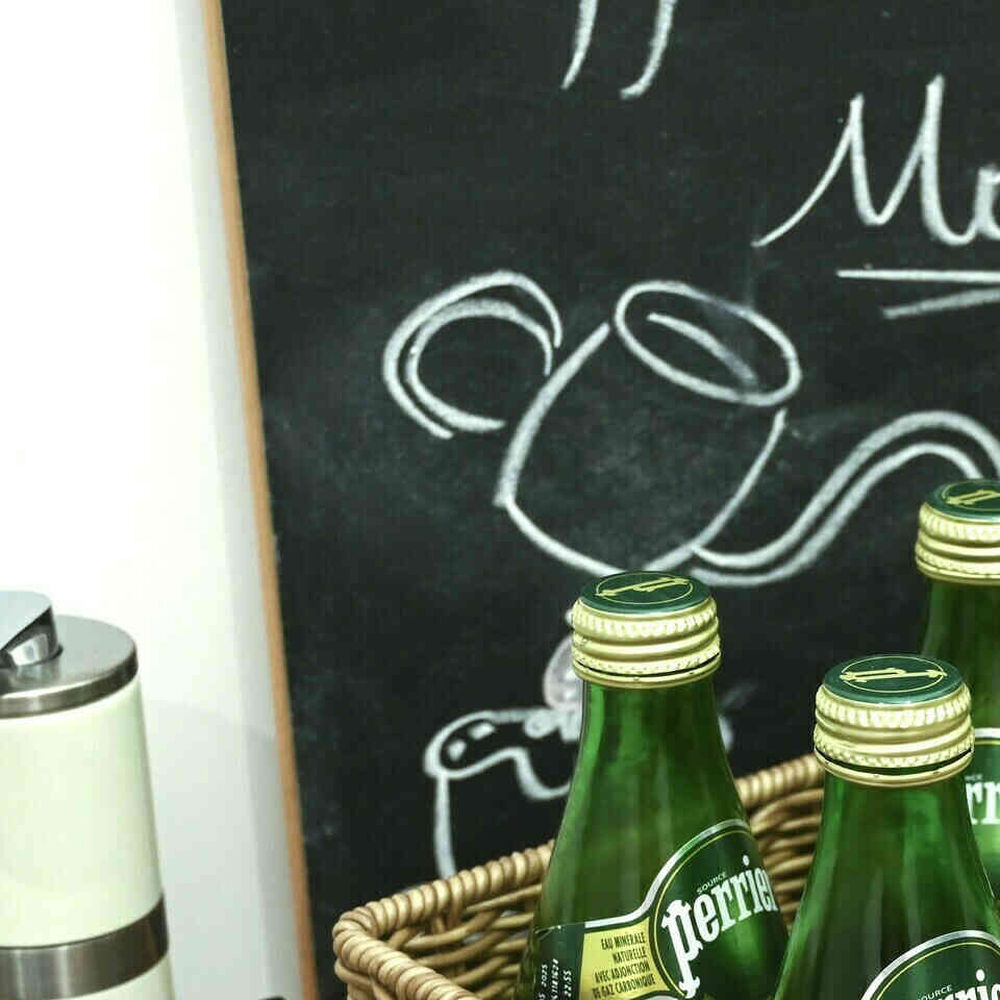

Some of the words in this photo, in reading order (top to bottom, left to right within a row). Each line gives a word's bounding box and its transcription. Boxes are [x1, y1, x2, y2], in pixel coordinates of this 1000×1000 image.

[696, 871, 727, 895] SOURCE
[601, 938, 614, 950] EAU
[613, 946, 647, 963] NATURELLE
[595, 970, 611, 983] AVEC
[611, 961, 650, 979] ADJONCTION
[601, 984, 615, 998] GAZ
[615, 974, 656, 993] CARBONIQUE
